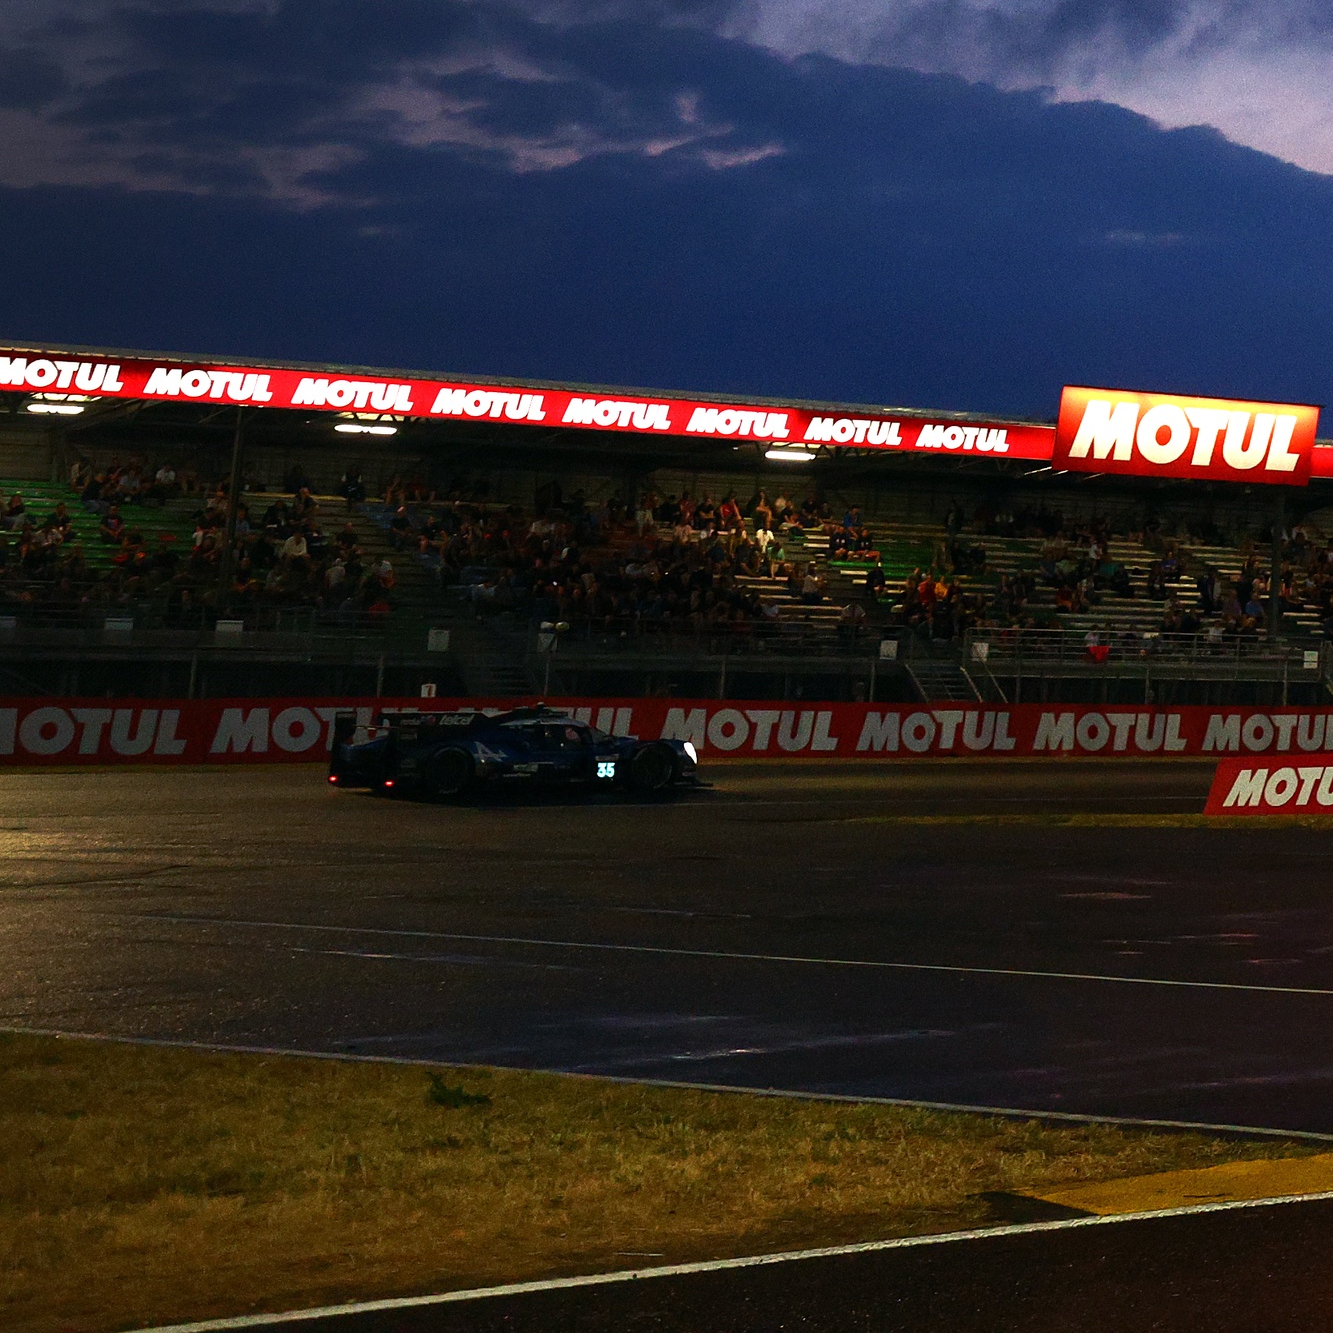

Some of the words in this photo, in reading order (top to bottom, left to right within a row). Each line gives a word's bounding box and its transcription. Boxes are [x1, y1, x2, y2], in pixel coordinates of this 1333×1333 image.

[0, 357, 124, 393] MOTUL
[144, 368, 274, 403] MOTUL
[291, 378, 415, 413] MOTUL
[431, 388, 547, 422] MOTUL
[562, 398, 672, 431] MOTUL
[686, 408, 791, 440] MOTUL
[804, 417, 904, 447] MOTUL
[916, 425, 1011, 454] MOTUL
[1068, 399, 1301, 472] MOTUL
[660, 709, 839, 752] MOTUL
[857, 710, 1017, 752] MOTUL
[1034, 712, 1188, 752] MOTUL
[596, 762, 616, 778] 35
